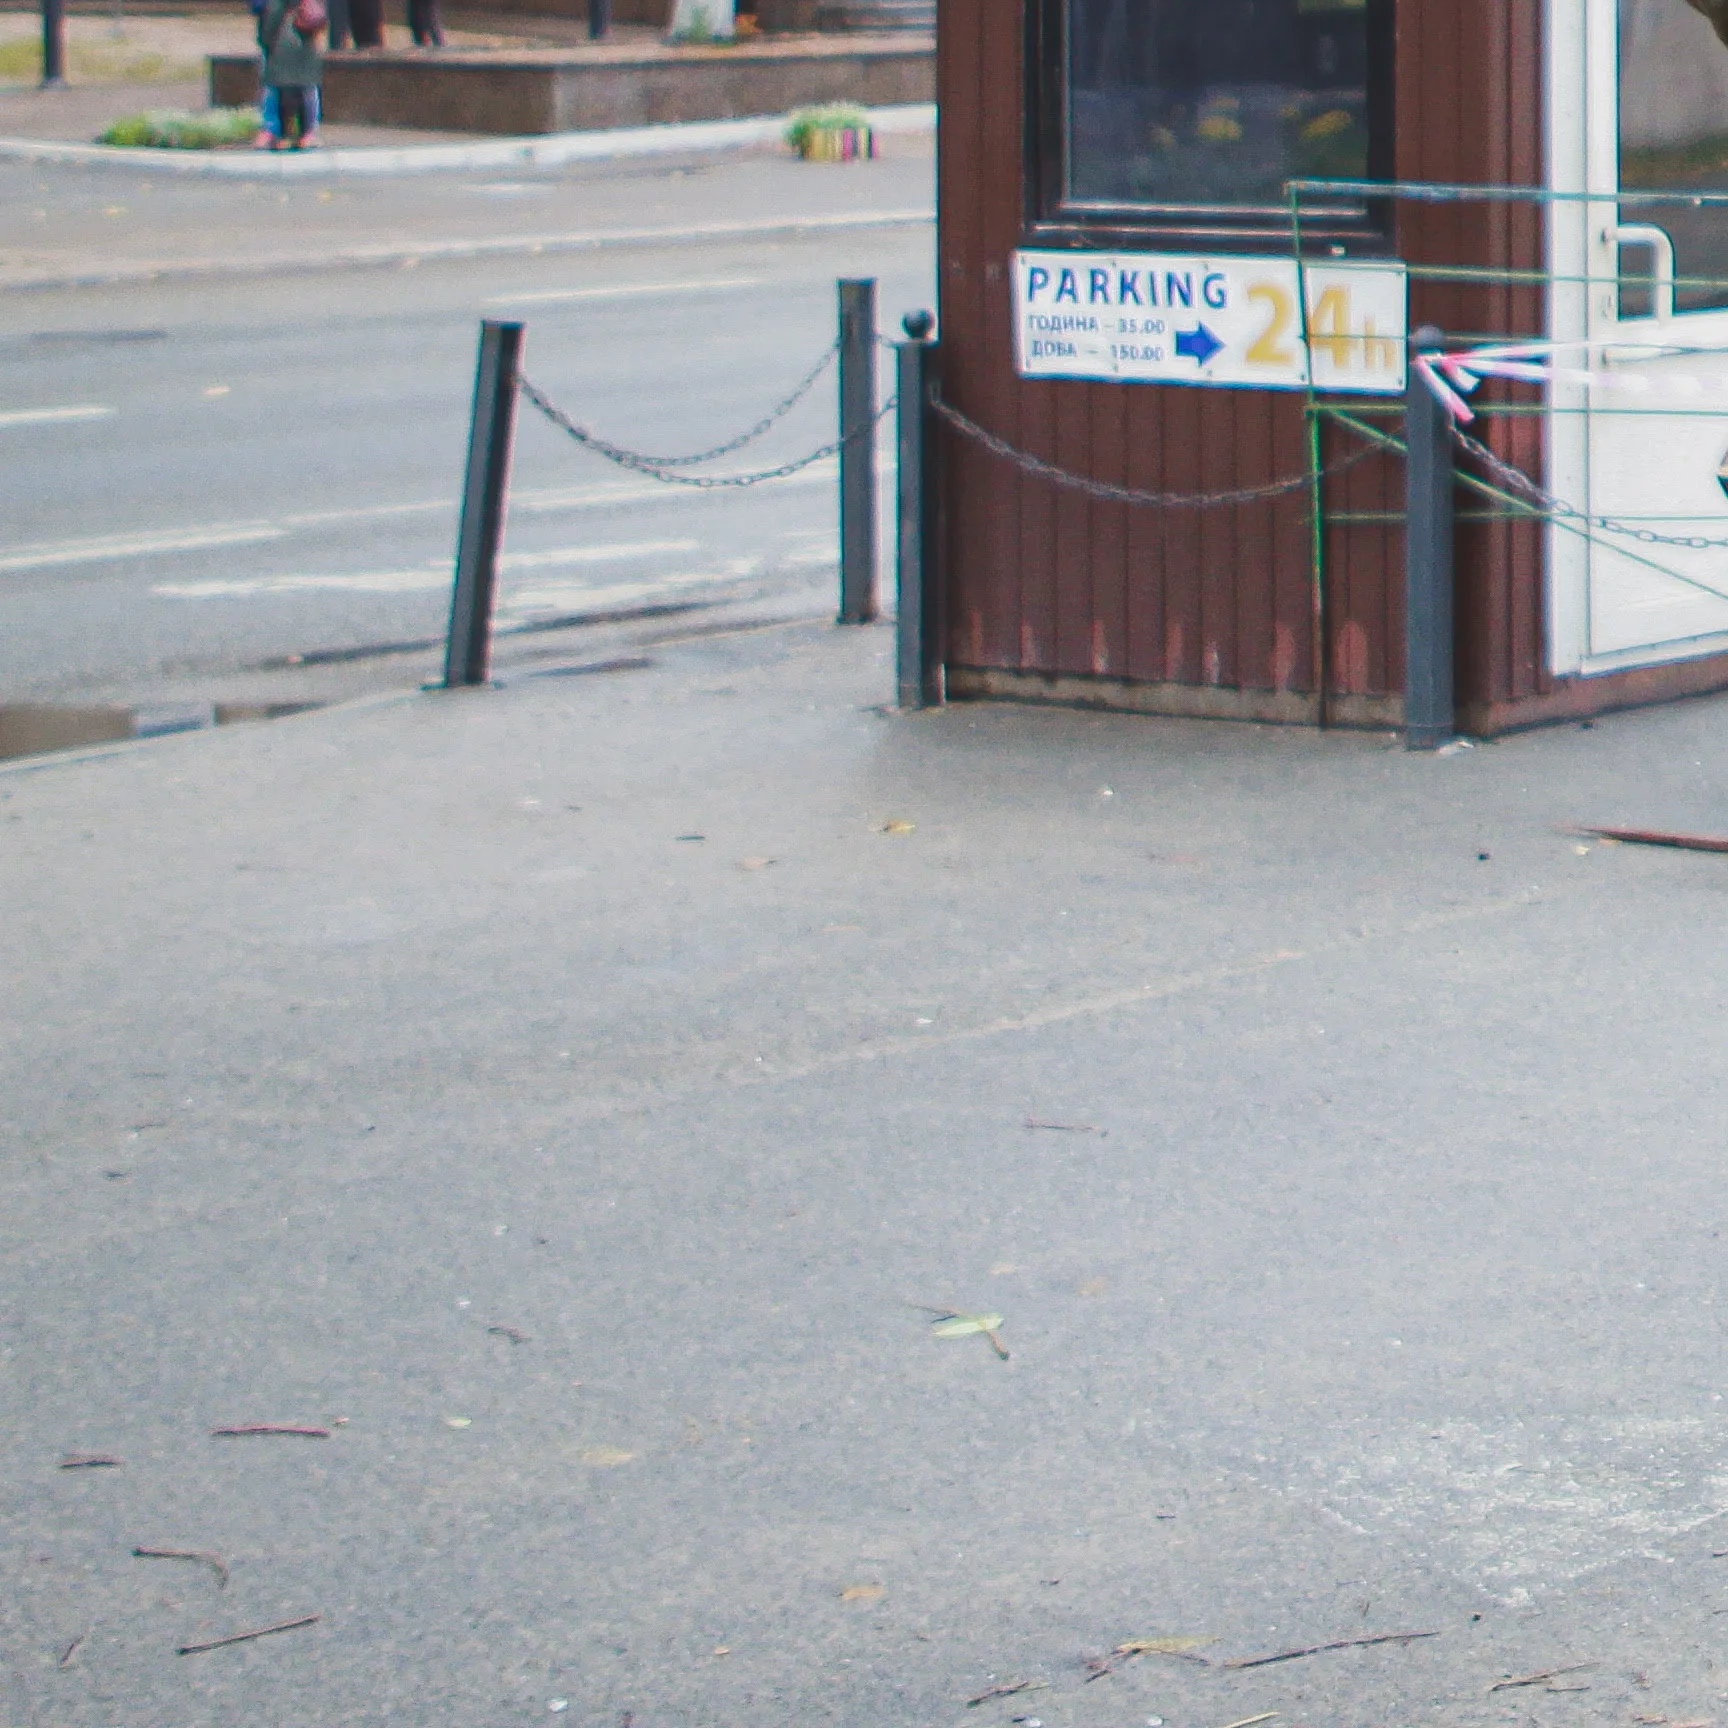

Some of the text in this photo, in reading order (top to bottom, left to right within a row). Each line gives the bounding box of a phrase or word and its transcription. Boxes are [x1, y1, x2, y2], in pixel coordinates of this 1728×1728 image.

[1027, 266, 1228, 309] PARKING
[1028, 314, 1098, 334] ГОДИНА
[1031, 339, 1077, 359] ДОБА
